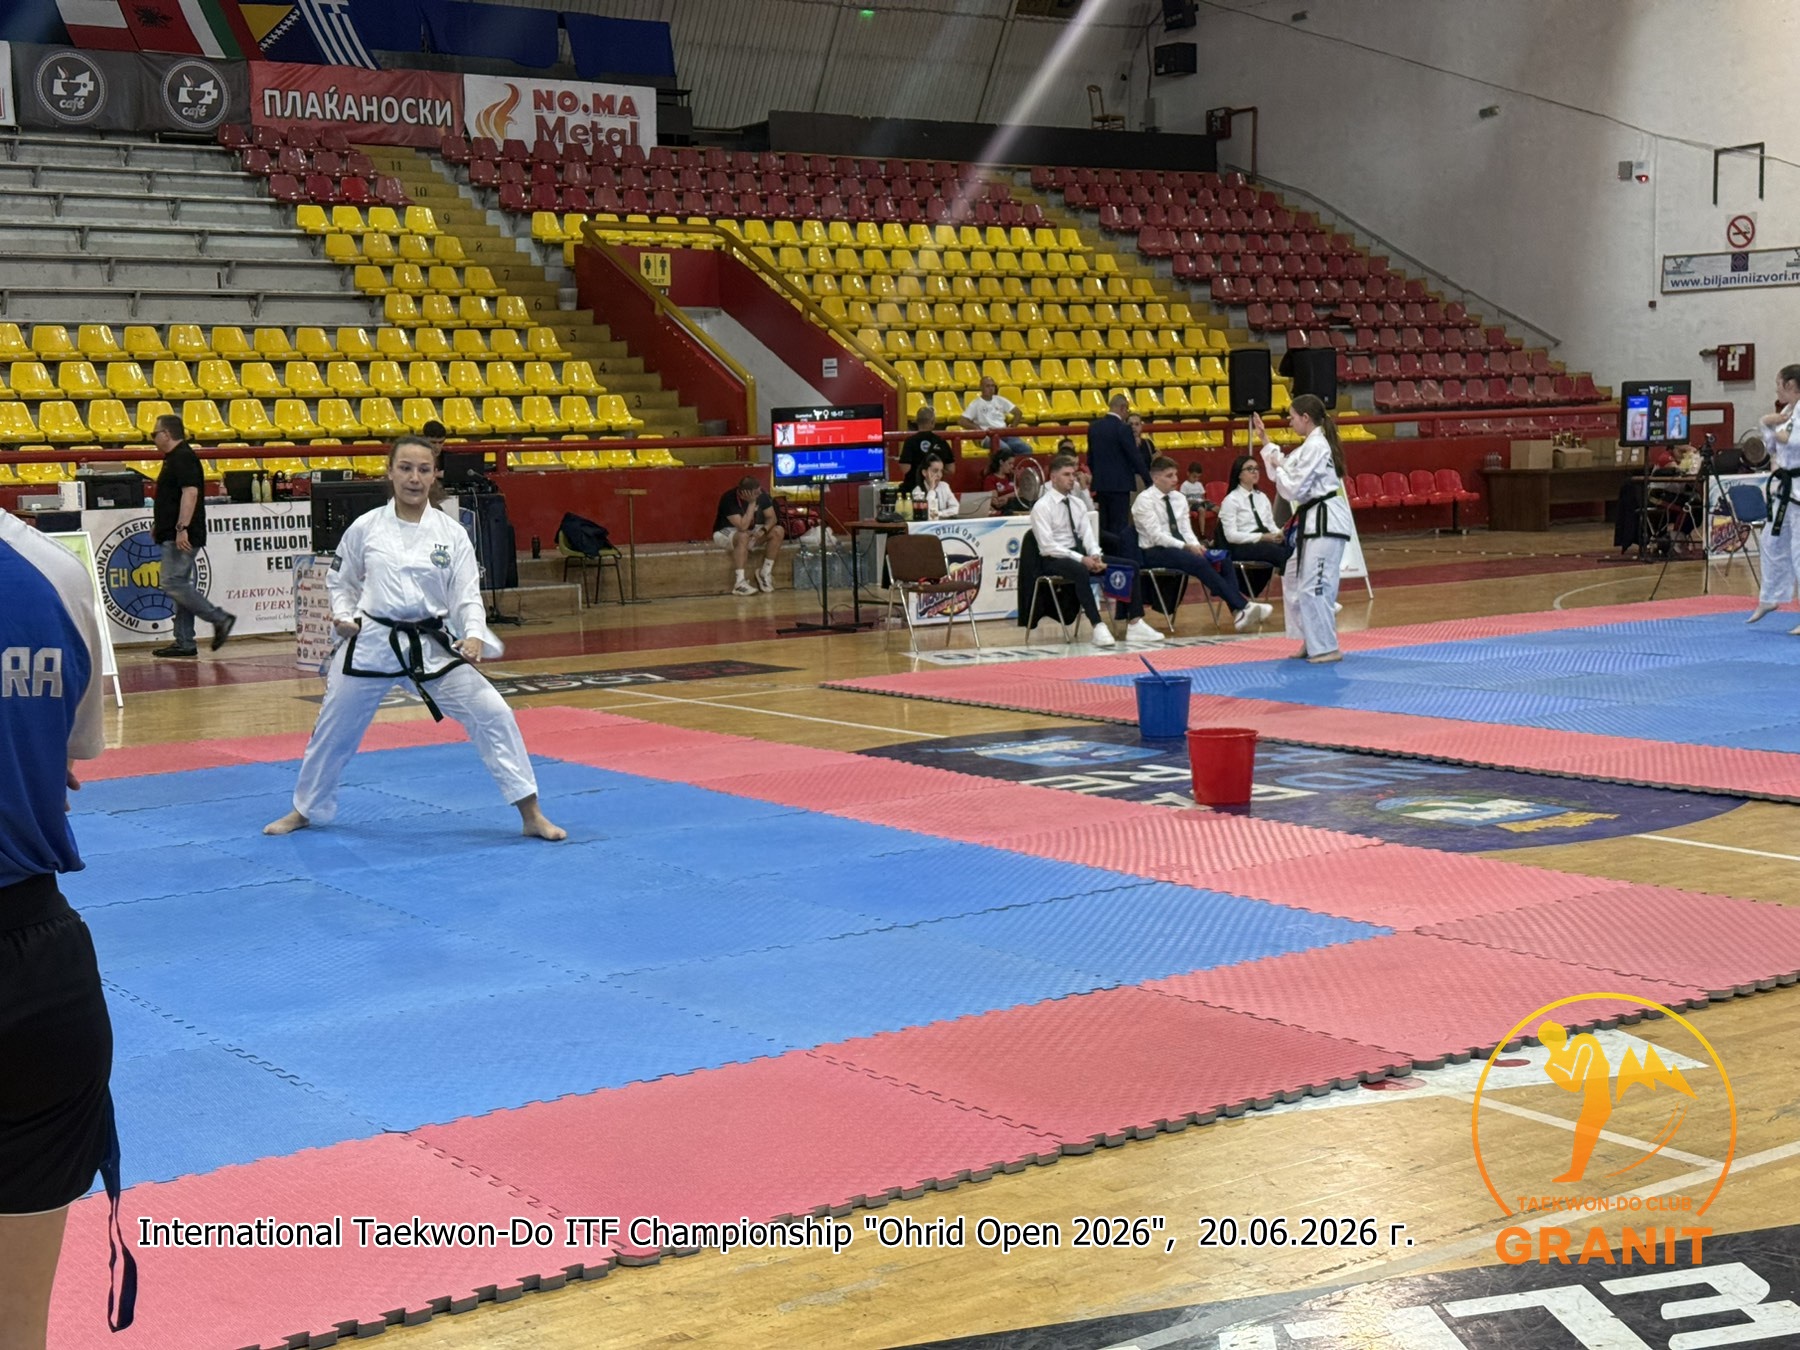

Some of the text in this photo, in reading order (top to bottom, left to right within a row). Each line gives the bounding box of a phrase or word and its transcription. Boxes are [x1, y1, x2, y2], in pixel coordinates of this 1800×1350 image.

[59, 97, 85, 112] café
[263, 86, 452, 127] ПЛАЌАНОСКИ
[533, 89, 638, 117] NO.MA
[182, 104, 207, 119] café
[535, 115, 638, 147] Metal
[414, 187, 427, 197] 10
[443, 213, 450, 224] 9
[503, 269, 511, 280] 7
[534, 298, 542, 310] 6
[569, 329, 577, 342] 5
[599, 362, 607, 373] 4
[634, 395, 642, 408] 3
[935, 526, 960, 536] Ohrid
[2, 647, 63, 697] RA
